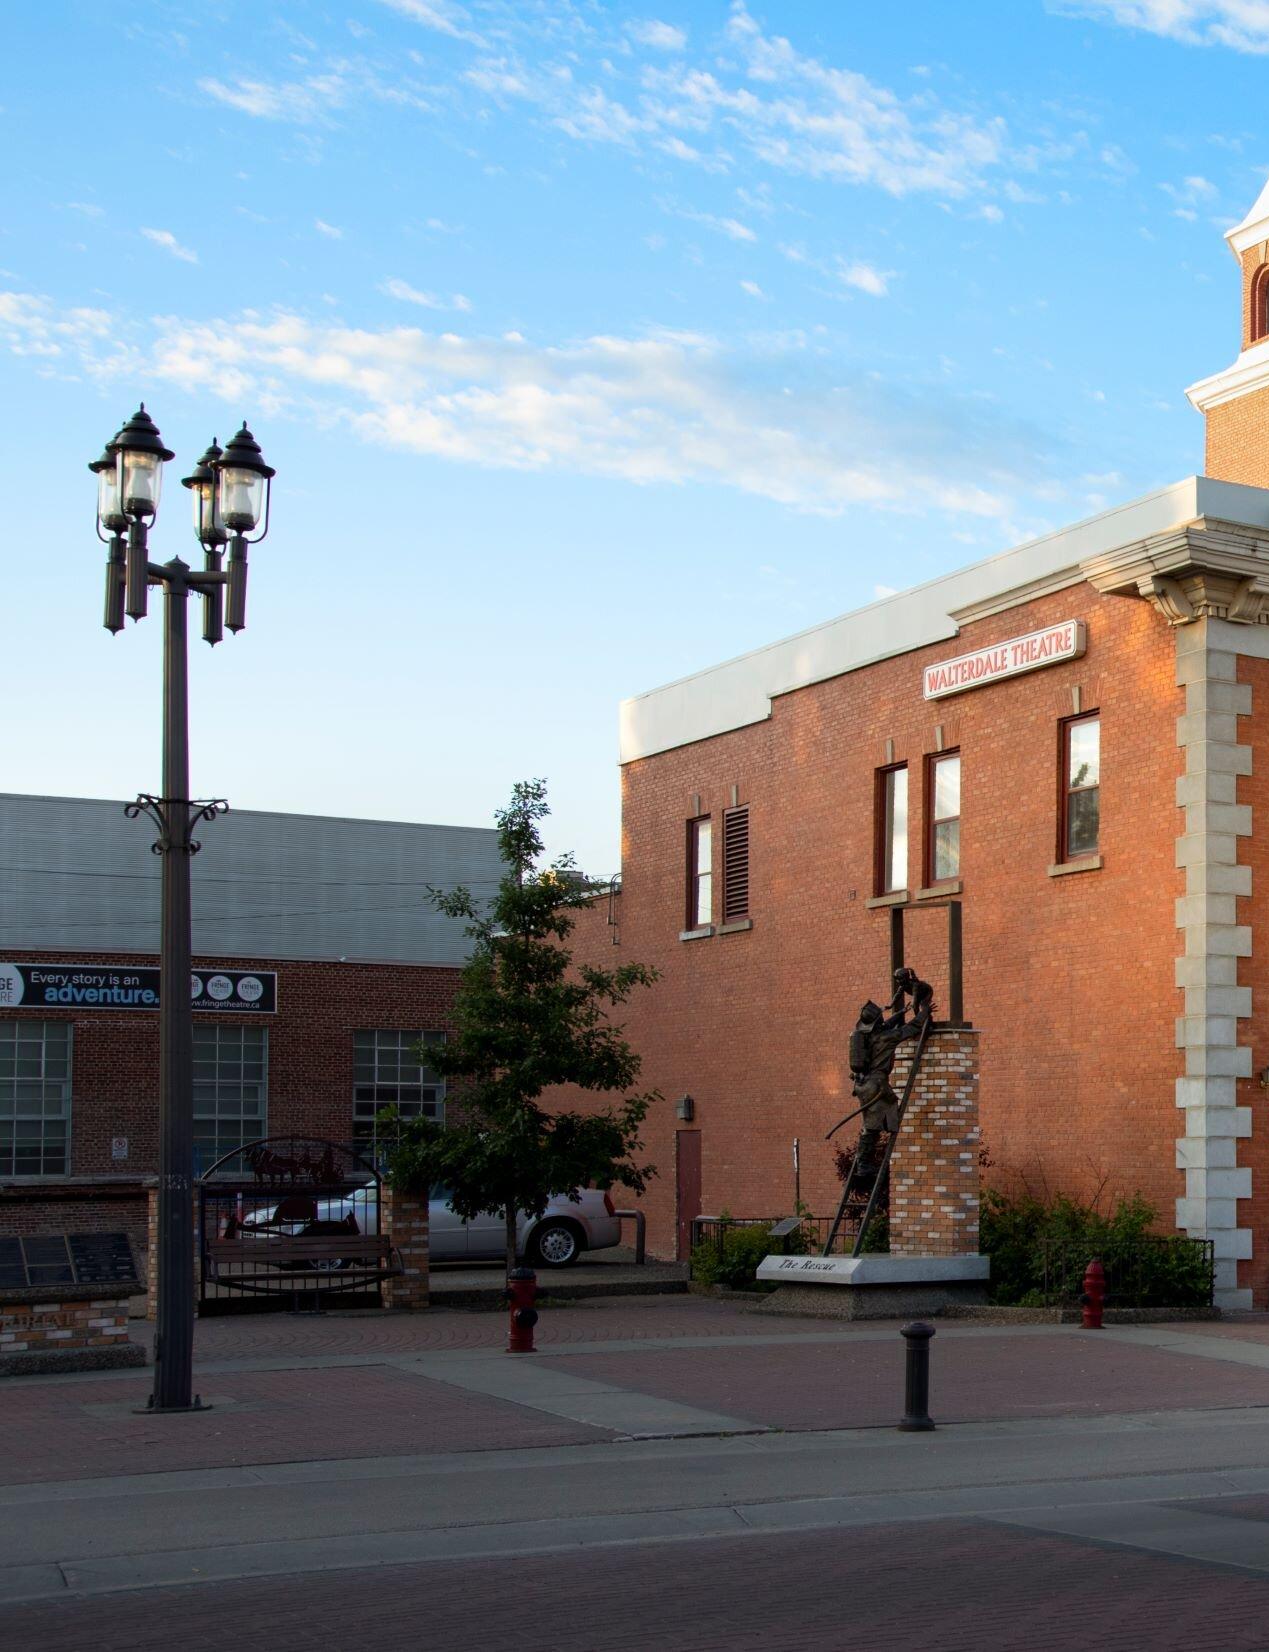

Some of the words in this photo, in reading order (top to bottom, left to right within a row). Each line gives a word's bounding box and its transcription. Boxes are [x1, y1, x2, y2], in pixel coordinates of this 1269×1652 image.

[928, 647, 1008, 692] WALTERDALE
[1011, 627, 1072, 667] THEATRE
[31, 971, 69, 988] Every
[72, 973, 106, 989] story
[109, 974, 120, 986] is
[123, 976, 140, 986] an
[44, 983, 160, 1005] adventure.
[778, 1259, 798, 1270] The
[800, 1259, 836, 1271] Rescue
